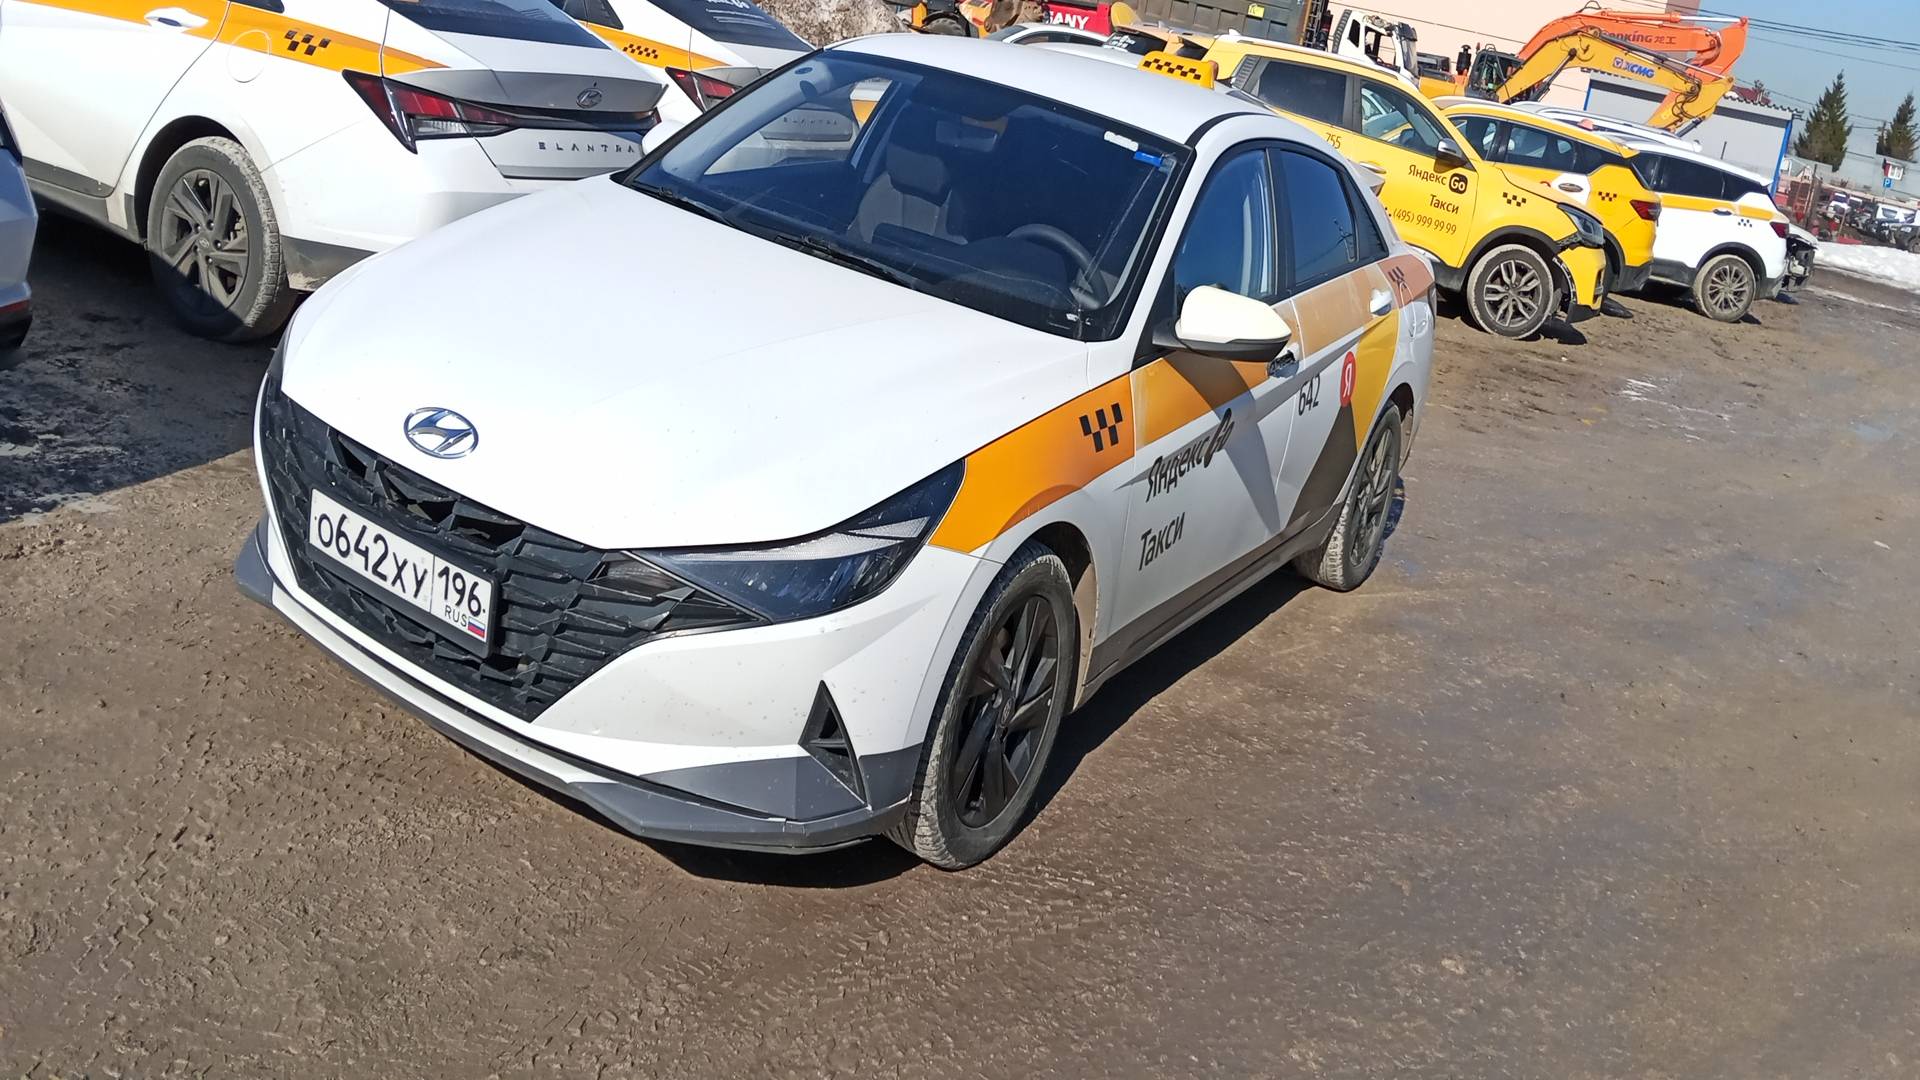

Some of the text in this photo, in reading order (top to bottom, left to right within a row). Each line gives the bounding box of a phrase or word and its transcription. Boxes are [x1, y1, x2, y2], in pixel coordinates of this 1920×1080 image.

[538, 142, 635, 153] ELANTRA
[1326, 132, 1341, 149] 755
[1408, 164, 1466, 191] Яндекс Go
[1429, 194, 1459, 215] Такси
[1393, 208, 1457, 235] (495) 999 99 99
[1297, 376, 1321, 416] 642
[1145, 437, 1208, 503] Яндекс
[1138, 511, 1186, 572] Такси
[437, 565, 482, 617] 196
[444, 604, 468, 628] RUS
